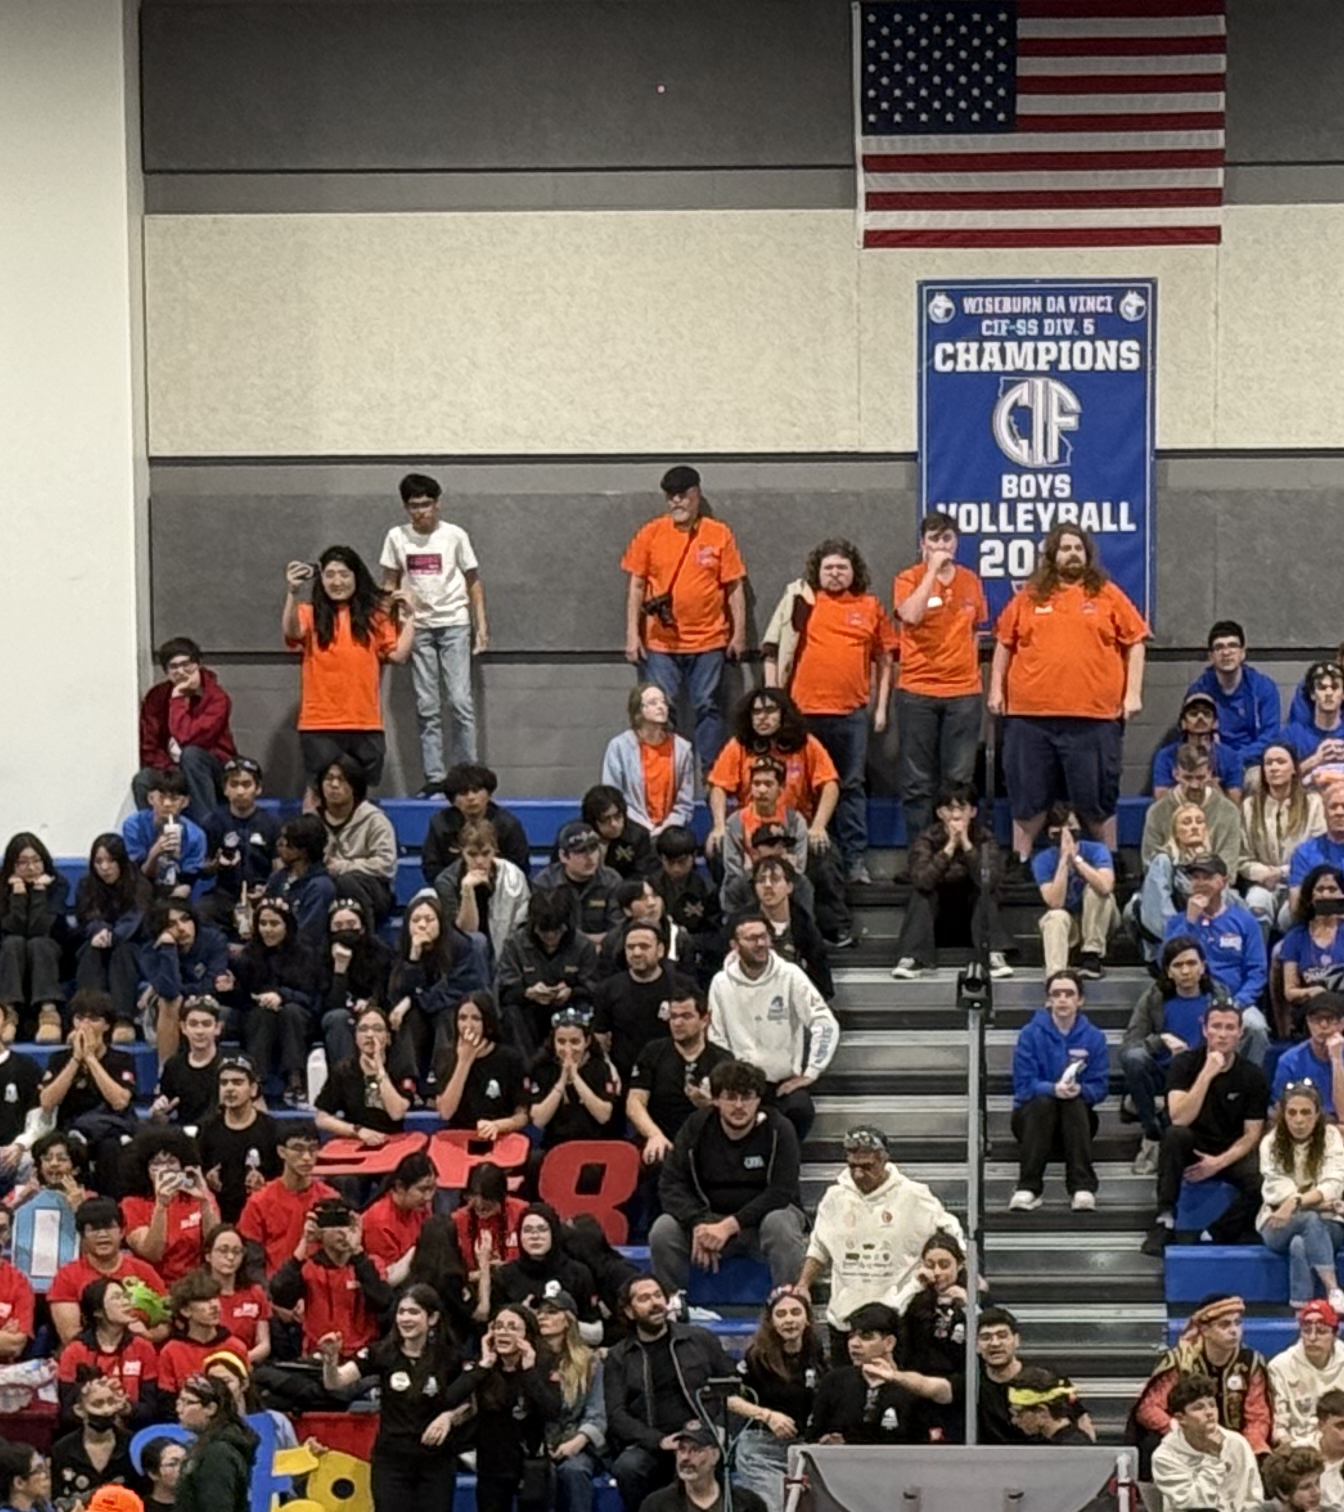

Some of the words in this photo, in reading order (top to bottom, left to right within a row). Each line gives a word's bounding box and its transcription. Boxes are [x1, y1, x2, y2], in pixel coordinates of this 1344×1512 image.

[963, 296, 1042, 314] WISEBURN
[1046, 297, 1067, 313] DA
[1068, 295, 1115, 313] VINCI
[981, 319, 1039, 336] CIF-SS
[1043, 319, 1079, 336] DIV.
[1083, 318, 1095, 335] 5
[934, 340, 1141, 372] CHAMPIONS
[1001, 474, 1071, 499] BOYS
